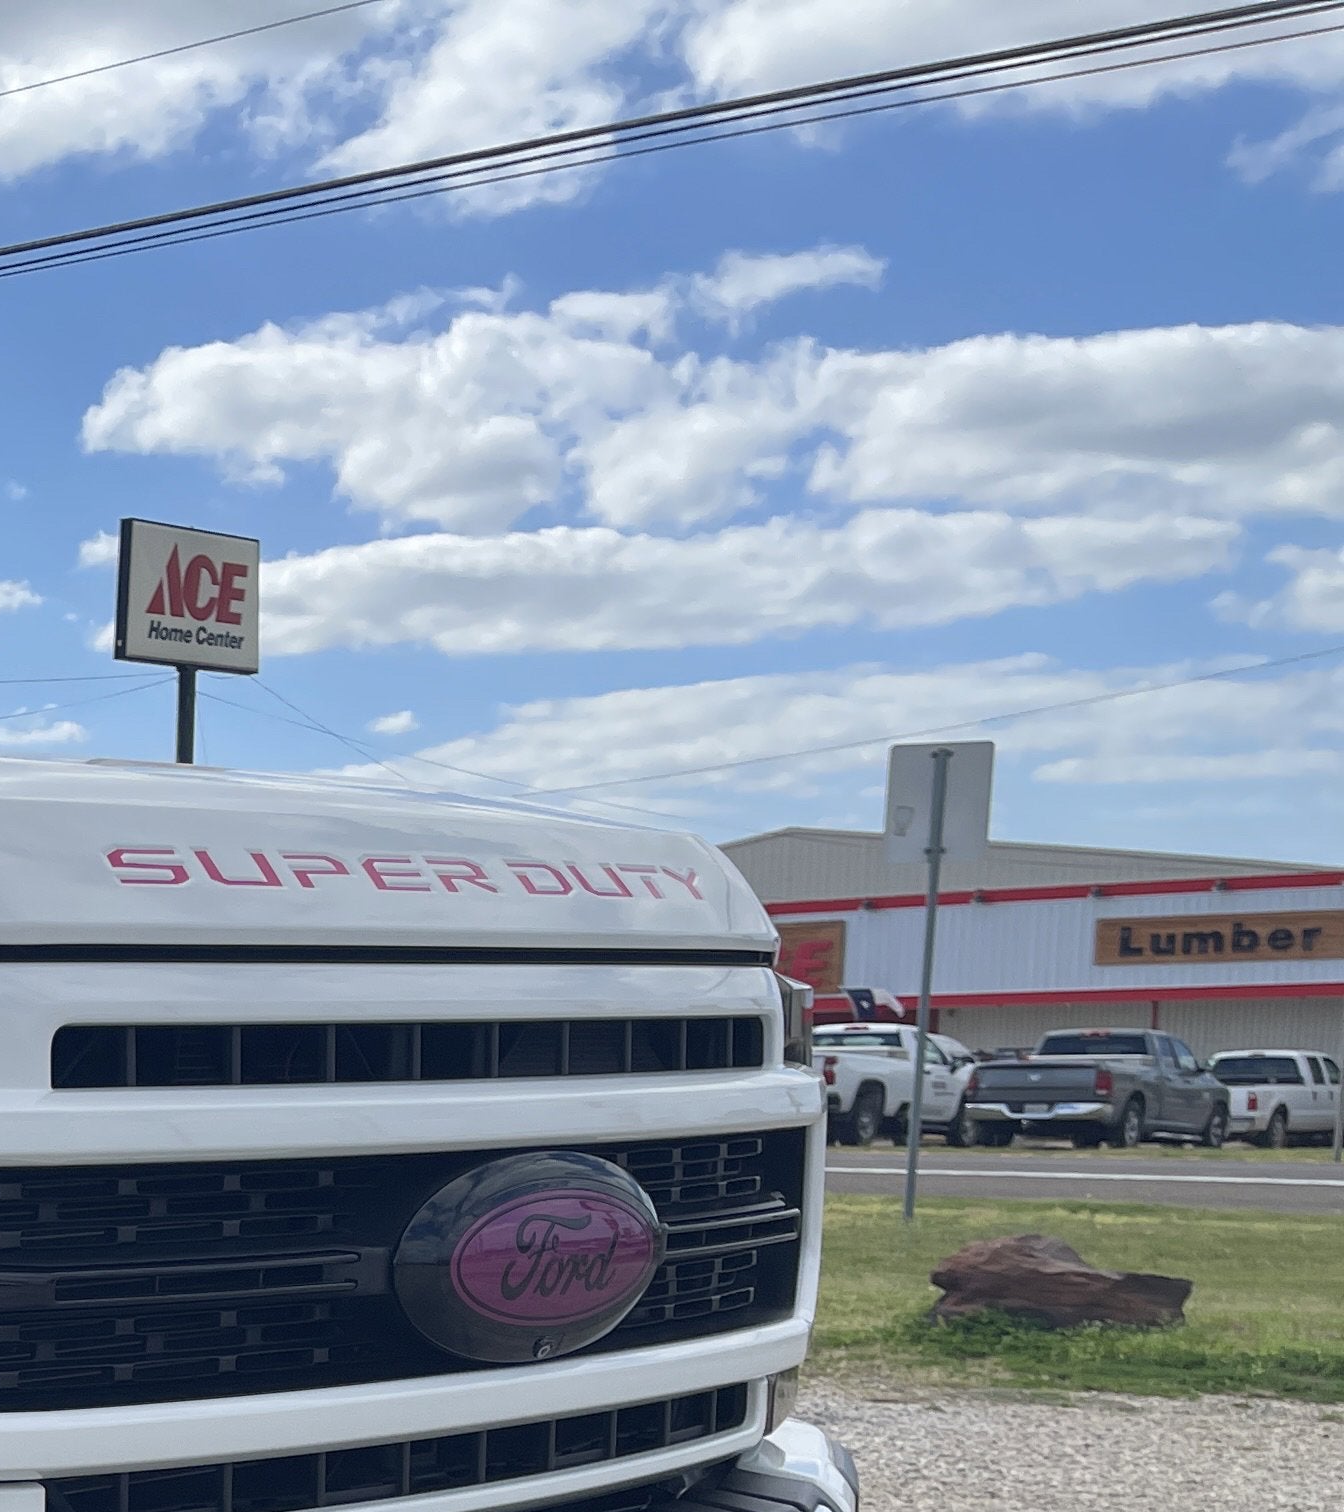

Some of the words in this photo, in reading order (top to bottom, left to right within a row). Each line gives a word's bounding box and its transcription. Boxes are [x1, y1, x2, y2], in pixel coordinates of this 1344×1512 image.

[146, 542, 248, 625] ACE
[148, 620, 192, 644] Home
[196, 626, 244, 649] Center
[106, 848, 499, 893] SUPER
[507, 862, 705, 900] DUTY
[1118, 921, 1322, 957] Lumber
[501, 1213, 619, 1300] Ford
